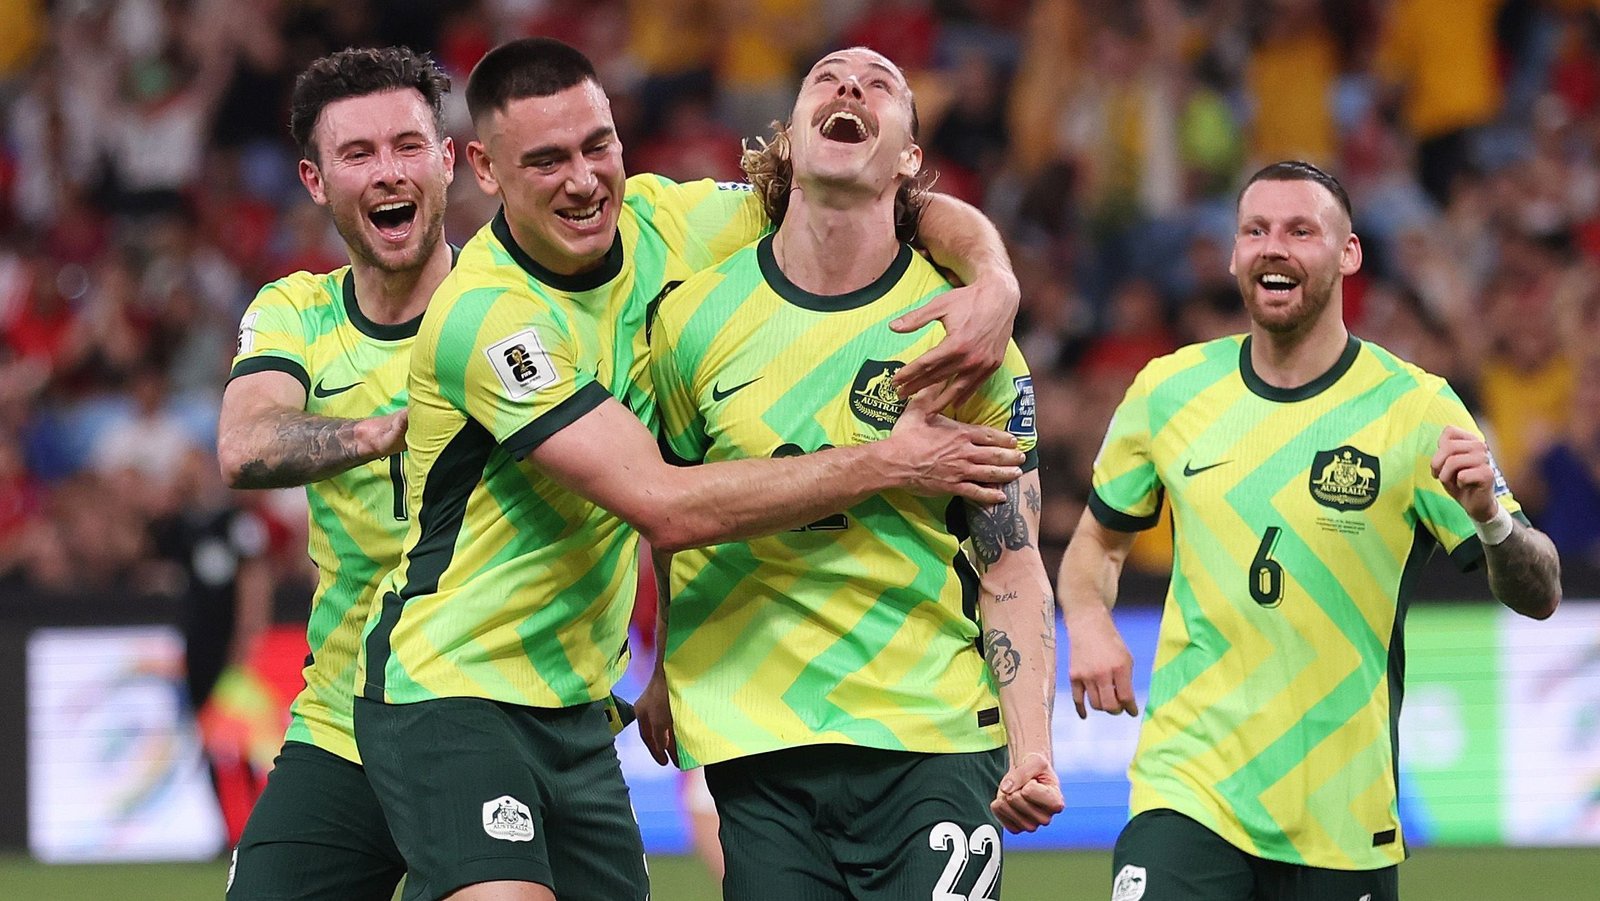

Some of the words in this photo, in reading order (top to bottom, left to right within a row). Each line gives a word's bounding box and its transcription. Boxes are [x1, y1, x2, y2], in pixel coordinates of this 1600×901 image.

[861, 396, 900, 413] AUSTRAL
[1320, 484, 1367, 496] AUSTRALIA
[1248, 526, 1285, 609] 6
[994, 591, 1018, 603] REAL
[929, 821, 1001, 901] 22
